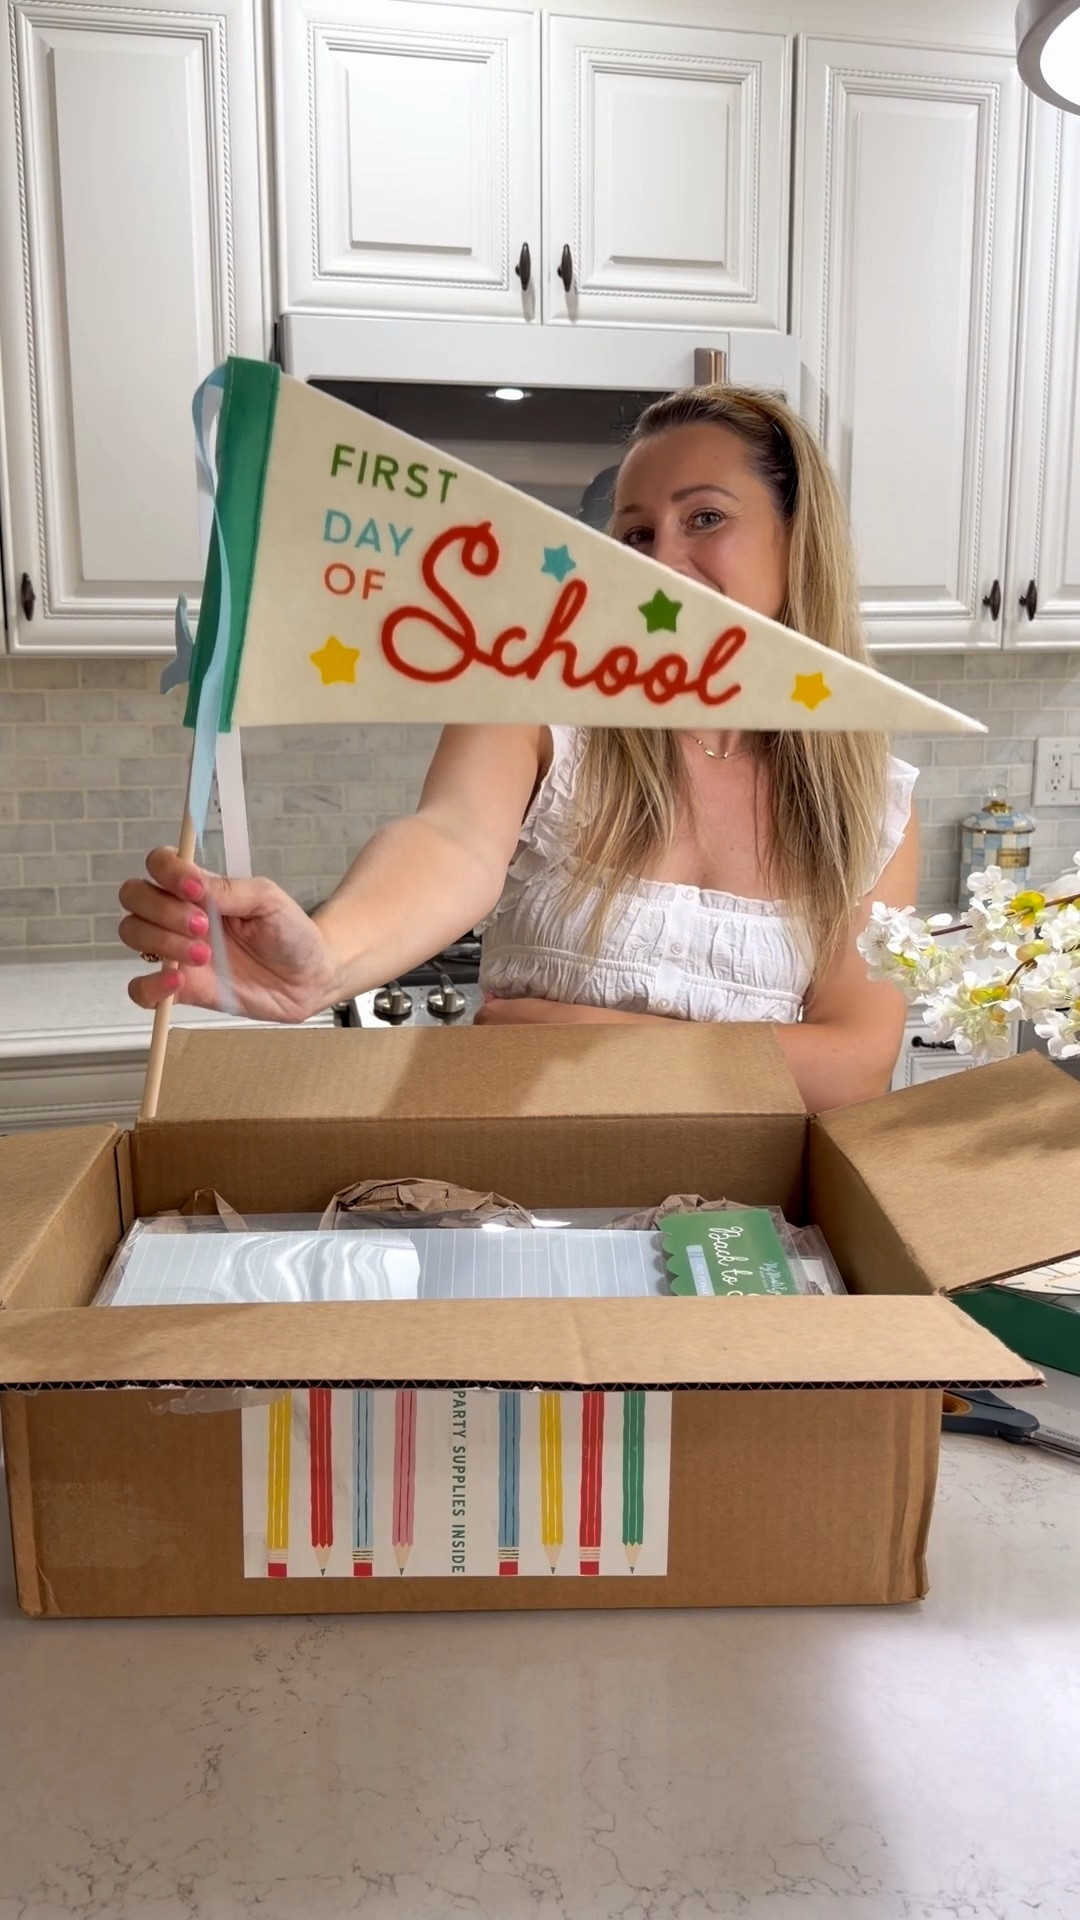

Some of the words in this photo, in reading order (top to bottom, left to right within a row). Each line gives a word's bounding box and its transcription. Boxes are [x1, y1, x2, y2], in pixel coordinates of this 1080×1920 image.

[331, 444, 457, 504] FIRST
[323, 509, 413, 557] DAY
[324, 563, 385, 599] OF
[381, 521, 747, 706] School
[708, 1226, 749, 1267] Back
[721, 1268, 753, 1285] to
[452, 1390, 466, 1438] PARTY
[452, 1446, 466, 1516] SUPPLIES
[452, 1524, 465, 1573] INSIDE
